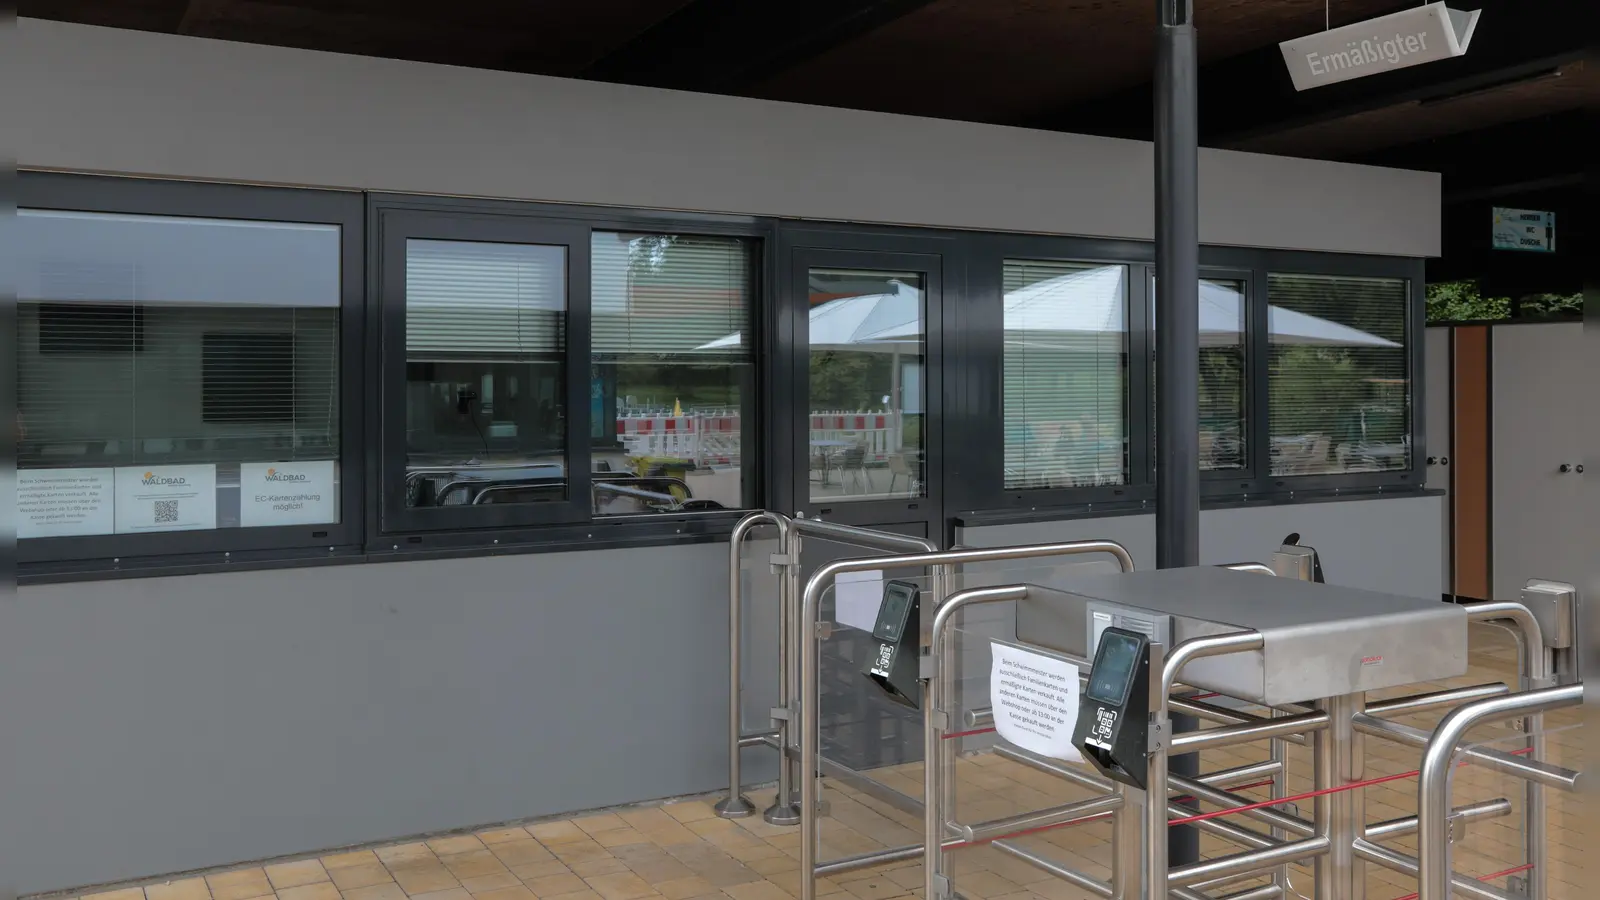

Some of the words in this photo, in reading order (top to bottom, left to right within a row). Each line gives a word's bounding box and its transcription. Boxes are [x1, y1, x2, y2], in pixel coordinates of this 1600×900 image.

[1306, 31, 1427, 76] Ermäßigter
[142, 477, 186, 486] WALDBAD
[264, 474, 306, 482] WALDBAD
[255, 493, 320, 502] EC-Kartenzahlung
[272, 502, 304, 512] möglich!
[1002, 658, 1012, 666] Beim
[1048, 672, 1066, 682] werden
[1027, 675, 1058, 692] Familienkarten
[1022, 685, 1036, 694] Karten
[1056, 695, 1065, 704] Alle
[1001, 699, 1020, 711] Webshop
[1020, 706, 1030, 714] oder
[1016, 694, 1030, 703] Karten
[1030, 698, 1048, 708] müssen
[1048, 703, 1058, 712] über
[1009, 712, 1022, 721] Kasse
[1022, 716, 1038, 728] gekauft
